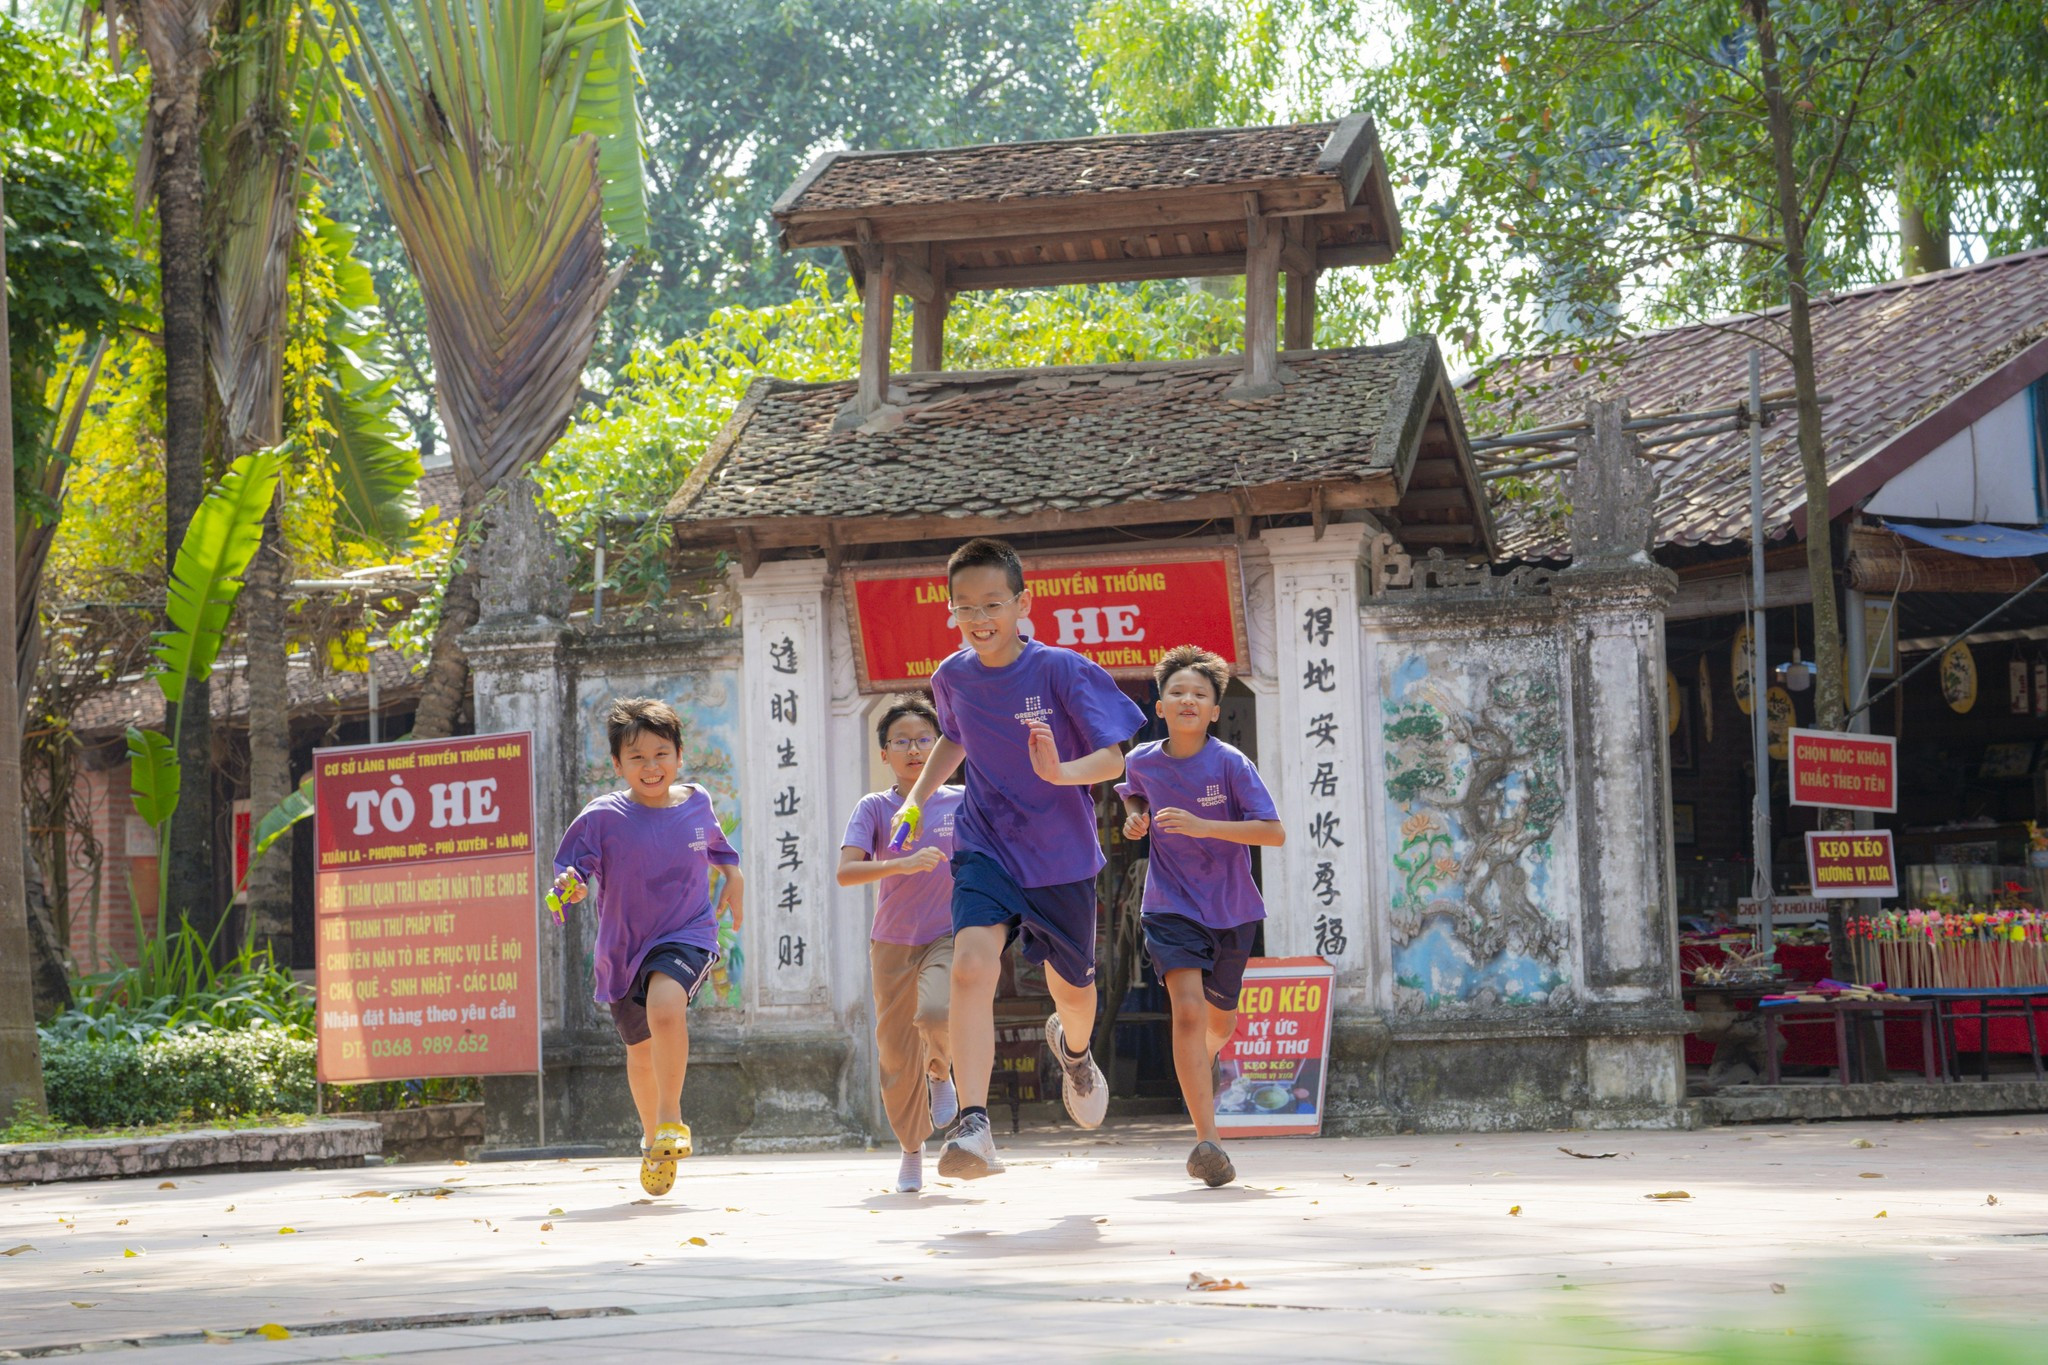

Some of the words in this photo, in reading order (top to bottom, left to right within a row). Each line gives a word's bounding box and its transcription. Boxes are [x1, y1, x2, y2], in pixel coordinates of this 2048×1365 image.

[915, 582, 950, 604] LÀN
[1102, 568, 1166, 593] THỐNG
[1053, 605, 1145, 645] HE
[906, 657, 942, 676] XUÂ
[1096, 647, 1146, 666] XUYÊN,
[1014, 708, 1053, 719] GREENFIELD
[324, 761, 339, 776] CƠ
[341, 757, 356, 775] SỞ
[357, 758, 385, 773] LÀNG
[460, 745, 495, 763] THỐNG
[1797, 745, 1827, 763] CHỌN
[1830, 745, 1854, 764] MÓC
[1856, 747, 1887, 766] KHÓA
[1832, 773, 1861, 790] THEO
[1864, 774, 1886, 792] TÊN
[346, 773, 415, 835] TÒ
[429, 777, 500, 829] HE
[322, 849, 347, 865] XUÂN
[349, 849, 361, 862] LA
[457, 836, 487, 853] XUYÊN
[496, 833, 509, 848] HÀ
[511, 832, 528, 849] NỘI
[1818, 841, 1850, 861] KẸO
[1852, 836, 1883, 857] KÉO
[373, 882, 395, 908] QUAN
[470, 869, 482, 898] TÒ
[484, 874, 496, 897] HE
[497, 873, 514, 896] CHO
[517, 866, 528, 895] BÉ
[1817, 865, 1853, 882] HƯƠNG
[1855, 866, 1867, 884] VỊ
[1868, 865, 1890, 881] XƯA
[349, 919, 381, 940] TRANH
[405, 911, 431, 936] PHÁP
[433, 909, 455, 937] VIỆT
[327, 947, 370, 971] CHUYÊN
[398, 944, 412, 967] TÒ
[416, 947, 430, 965] HE
[433, 945, 463, 967] PHỤC
[466, 944, 481, 966] VỤ
[502, 937, 522, 964] HỘI
[356, 975, 379, 1002] QUÊ
[391, 977, 417, 997] SINH
[421, 971, 452, 998] NHẬT
[463, 969, 487, 993] CÁC
[490, 971, 517, 994] LOẠI
[1238, 986, 1273, 1019] KẸO
[1278, 980, 1321, 1013] KÉO
[323, 1010, 358, 1031] Nhận
[362, 1008, 384, 1031] đặt
[388, 1007, 422, 1026] hàng
[427, 1005, 457, 1022] theo
[461, 1003, 486, 1024] yêu
[1248, 1018, 1271, 1036] KÝ
[1275, 1018, 1298, 1035] ỨC
[1234, 1035, 1271, 1055] TUỔI
[1276, 1038, 1310, 1054] THƠ
[1269, 1059, 1295, 1070] KÉO
